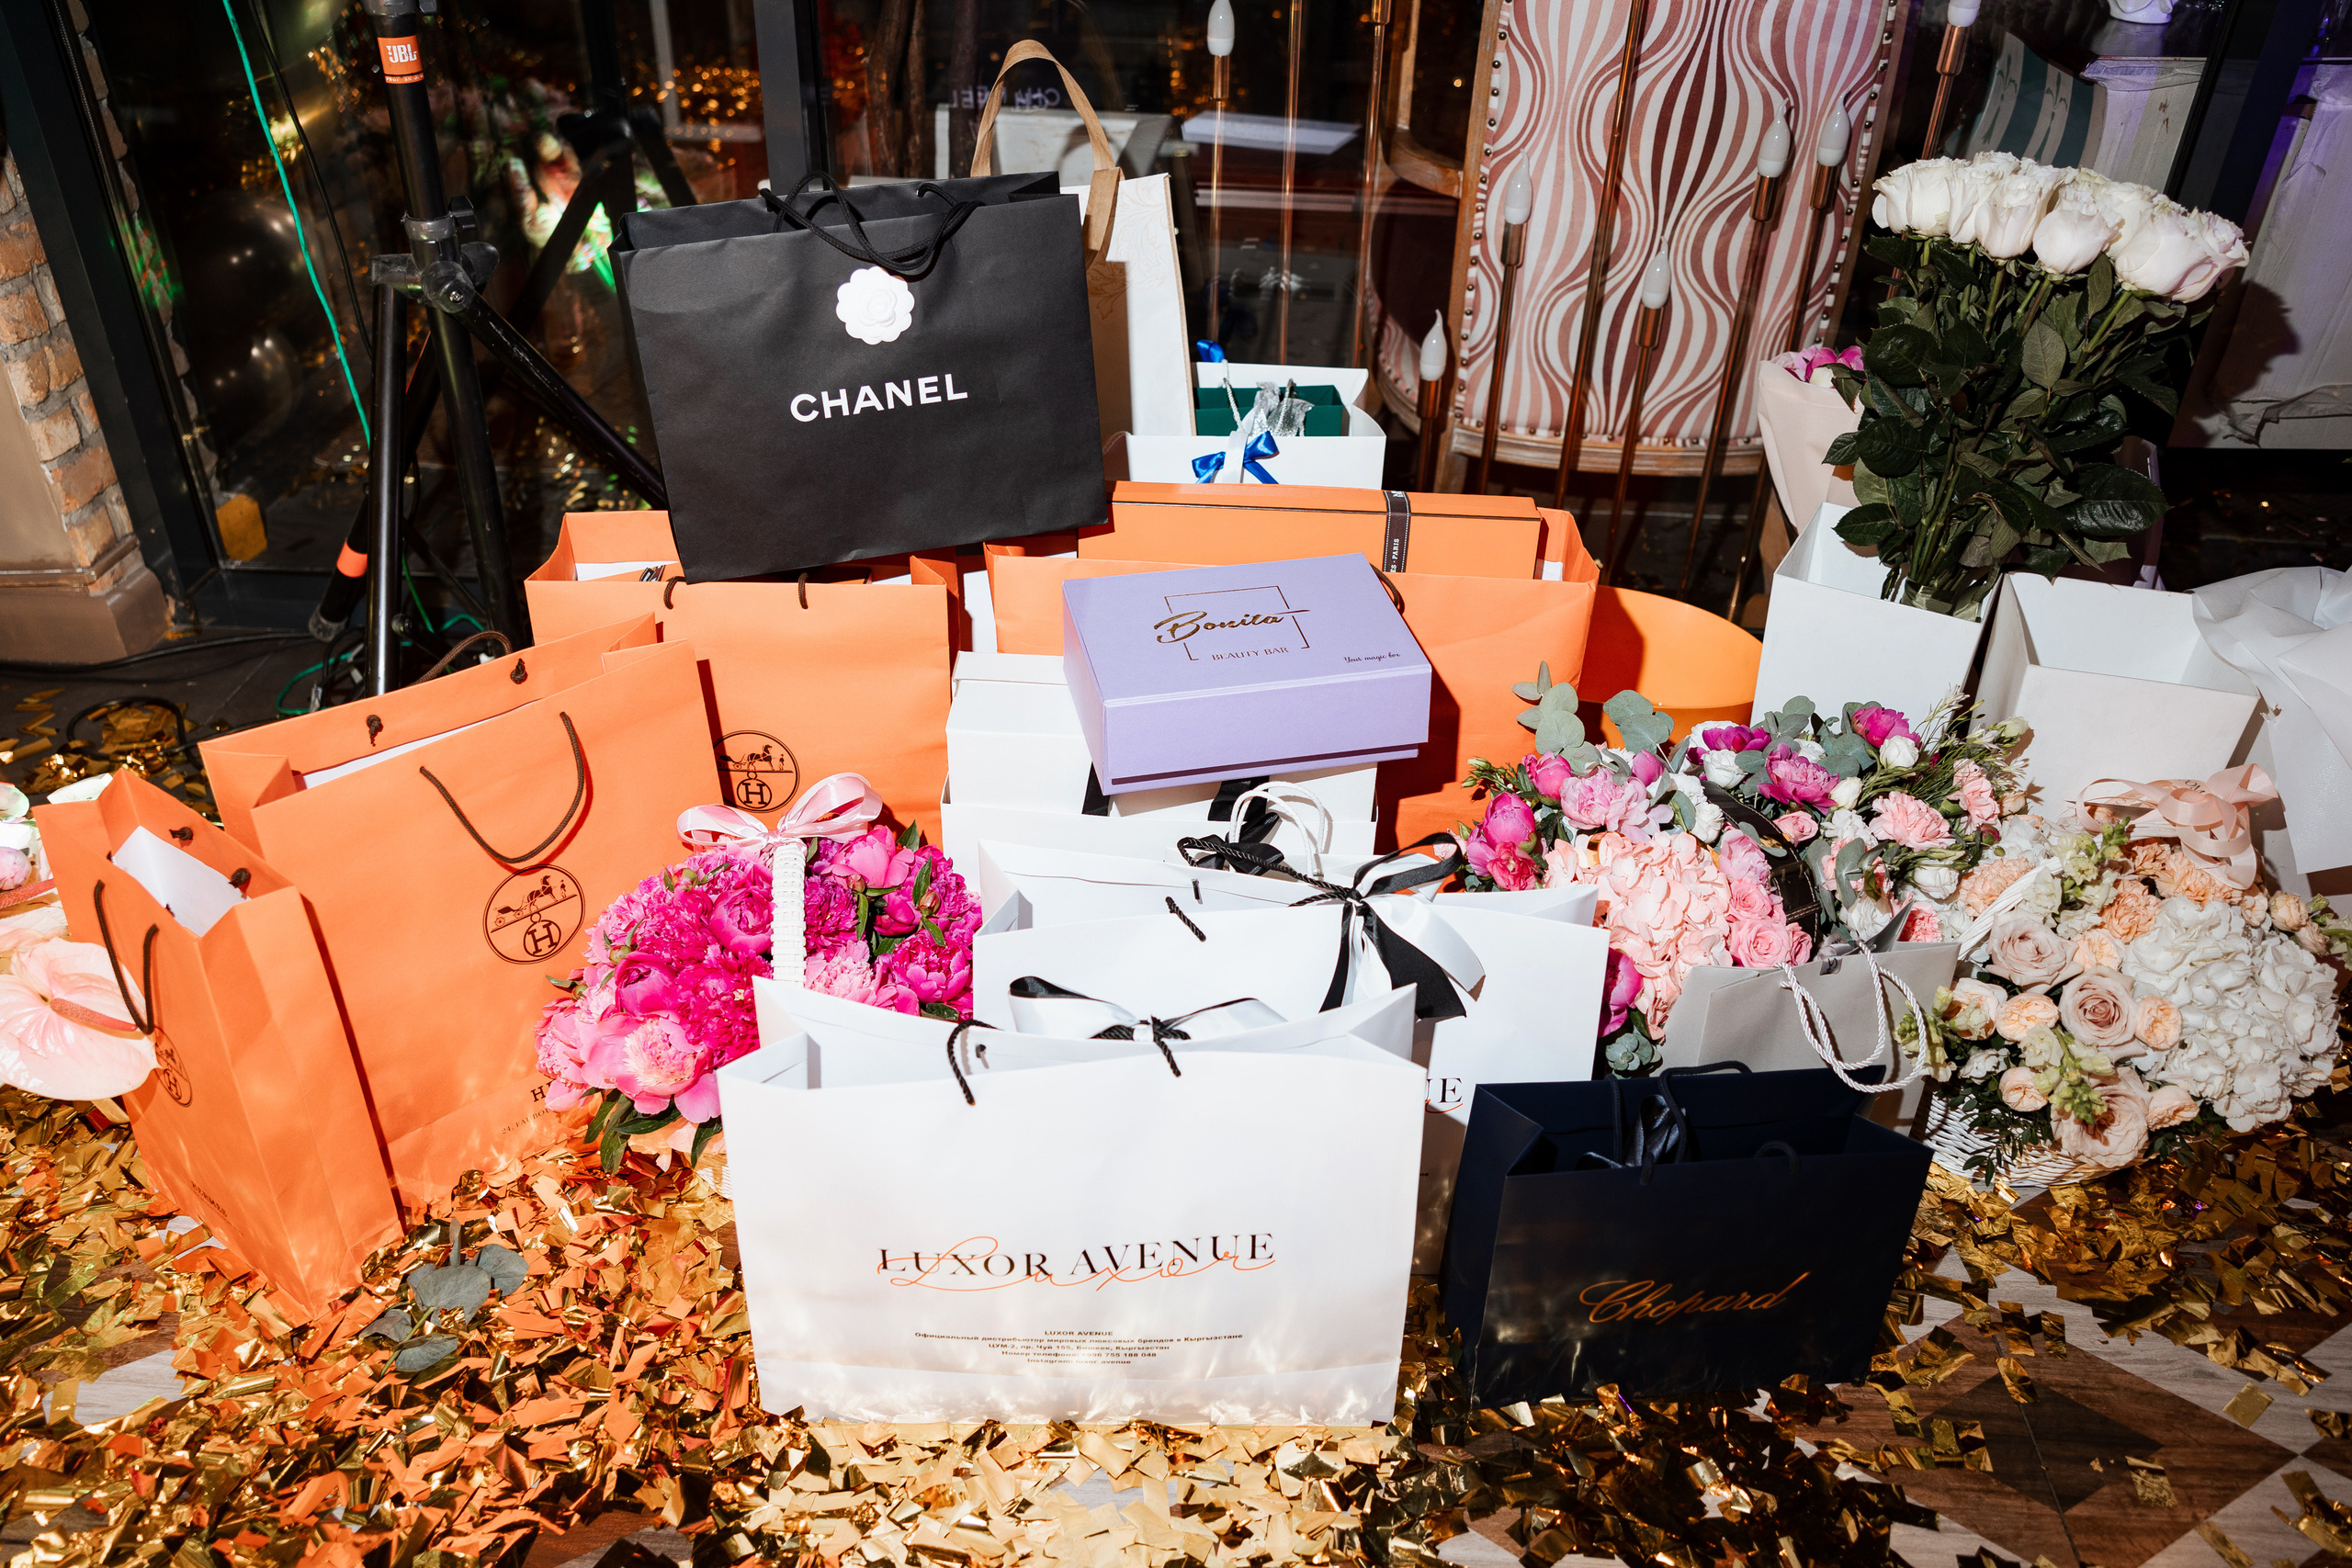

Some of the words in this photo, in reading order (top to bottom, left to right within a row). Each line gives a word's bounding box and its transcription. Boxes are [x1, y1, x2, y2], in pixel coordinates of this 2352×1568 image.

[386, 43, 417, 63] JBL
[790, 374, 968, 423] CHANEL
[1154, 610, 1310, 643] Bonita
[1212, 649, 1260, 660] BEAUTY
[1263, 647, 1289, 655] BAR
[877, 1247, 1050, 1277] LUXOR
[1069, 1233, 1274, 1276] AVENUE
[1578, 1271, 1811, 1325] Chopard
[1183, 1334, 1243, 1342] Кыргызстане
